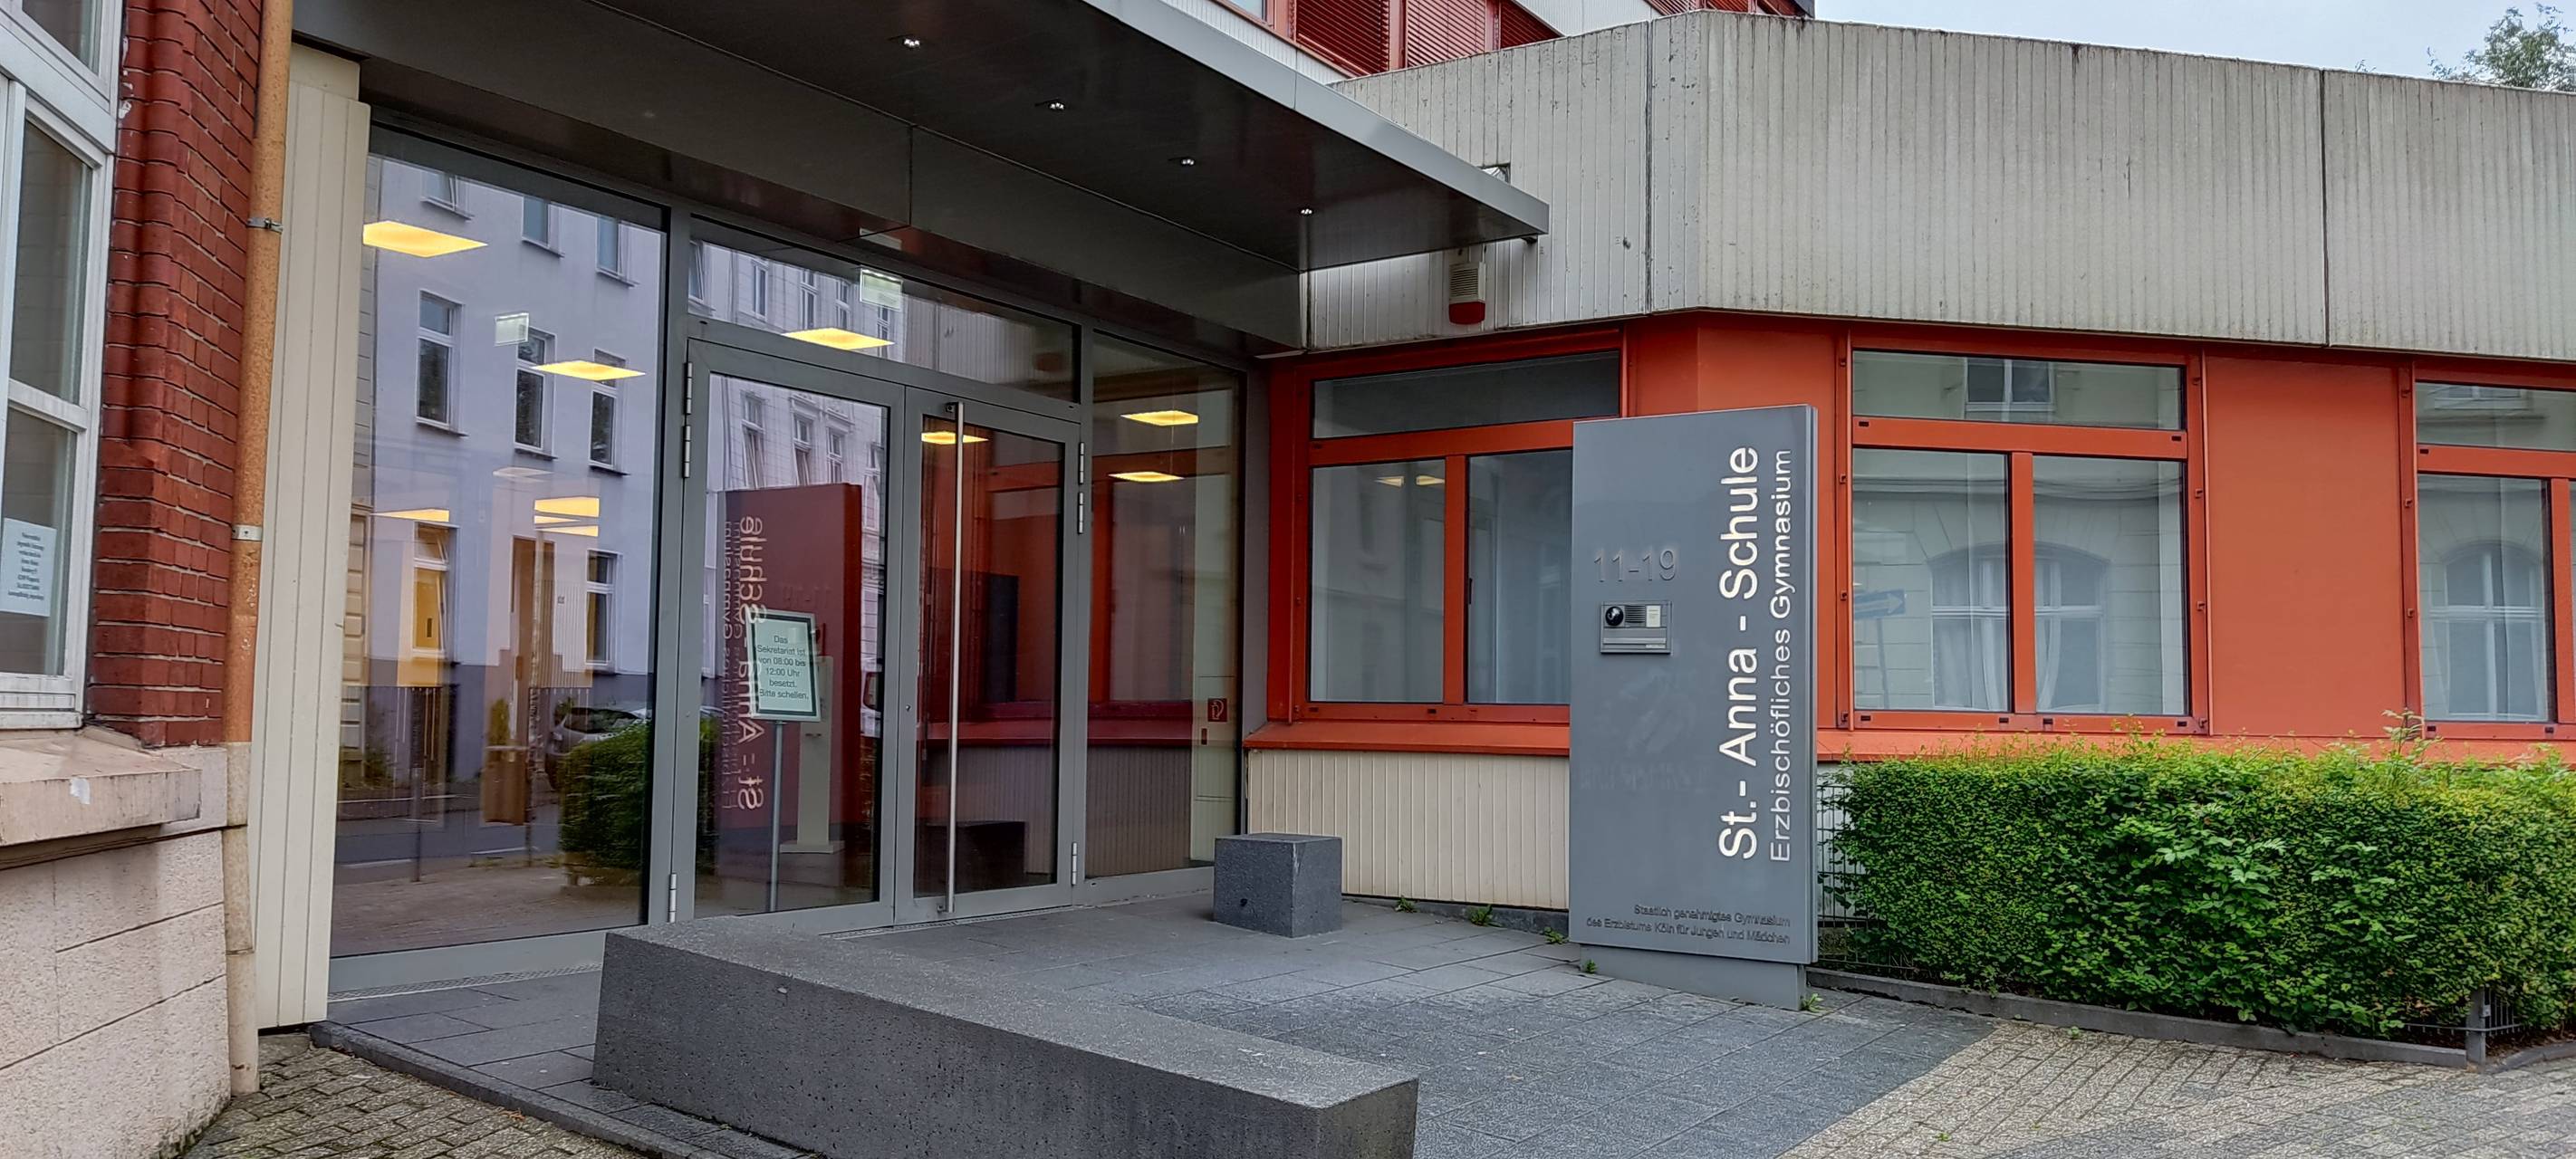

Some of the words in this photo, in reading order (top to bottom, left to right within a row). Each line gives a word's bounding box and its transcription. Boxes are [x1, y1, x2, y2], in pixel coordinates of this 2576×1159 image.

[1719, 447, 1758, 599] Schule
[1770, 451, 1795, 618] Gymnasium
[1594, 549, 1676, 582] 11-19
[757, 645, 795, 656] Sekretariat
[774, 636, 788, 644] Das
[766, 668, 785, 676] 12:00
[787, 669, 801, 677] Uhr
[773, 657, 793, 666] 08:00
[795, 658, 806, 666] bis
[1719, 647, 1757, 767] Anna
[1770, 628, 1791, 861] Erzbischöfliches
[1634, 905, 1672, 917] Staatlich
[1674, 909, 1732, 923] genehmigtes
[1734, 913, 1791, 927] Gymnasium
[1586, 917, 1602, 927] des
[1604, 918, 1652, 932] Erzbistums
[1654, 922, 1675, 934] Köln
[1677, 924, 1689, 934] für
[1690, 925, 1725, 940] Jungen
[1726, 929, 1745, 941] und
[1746, 930, 1791, 944] Mädchen
